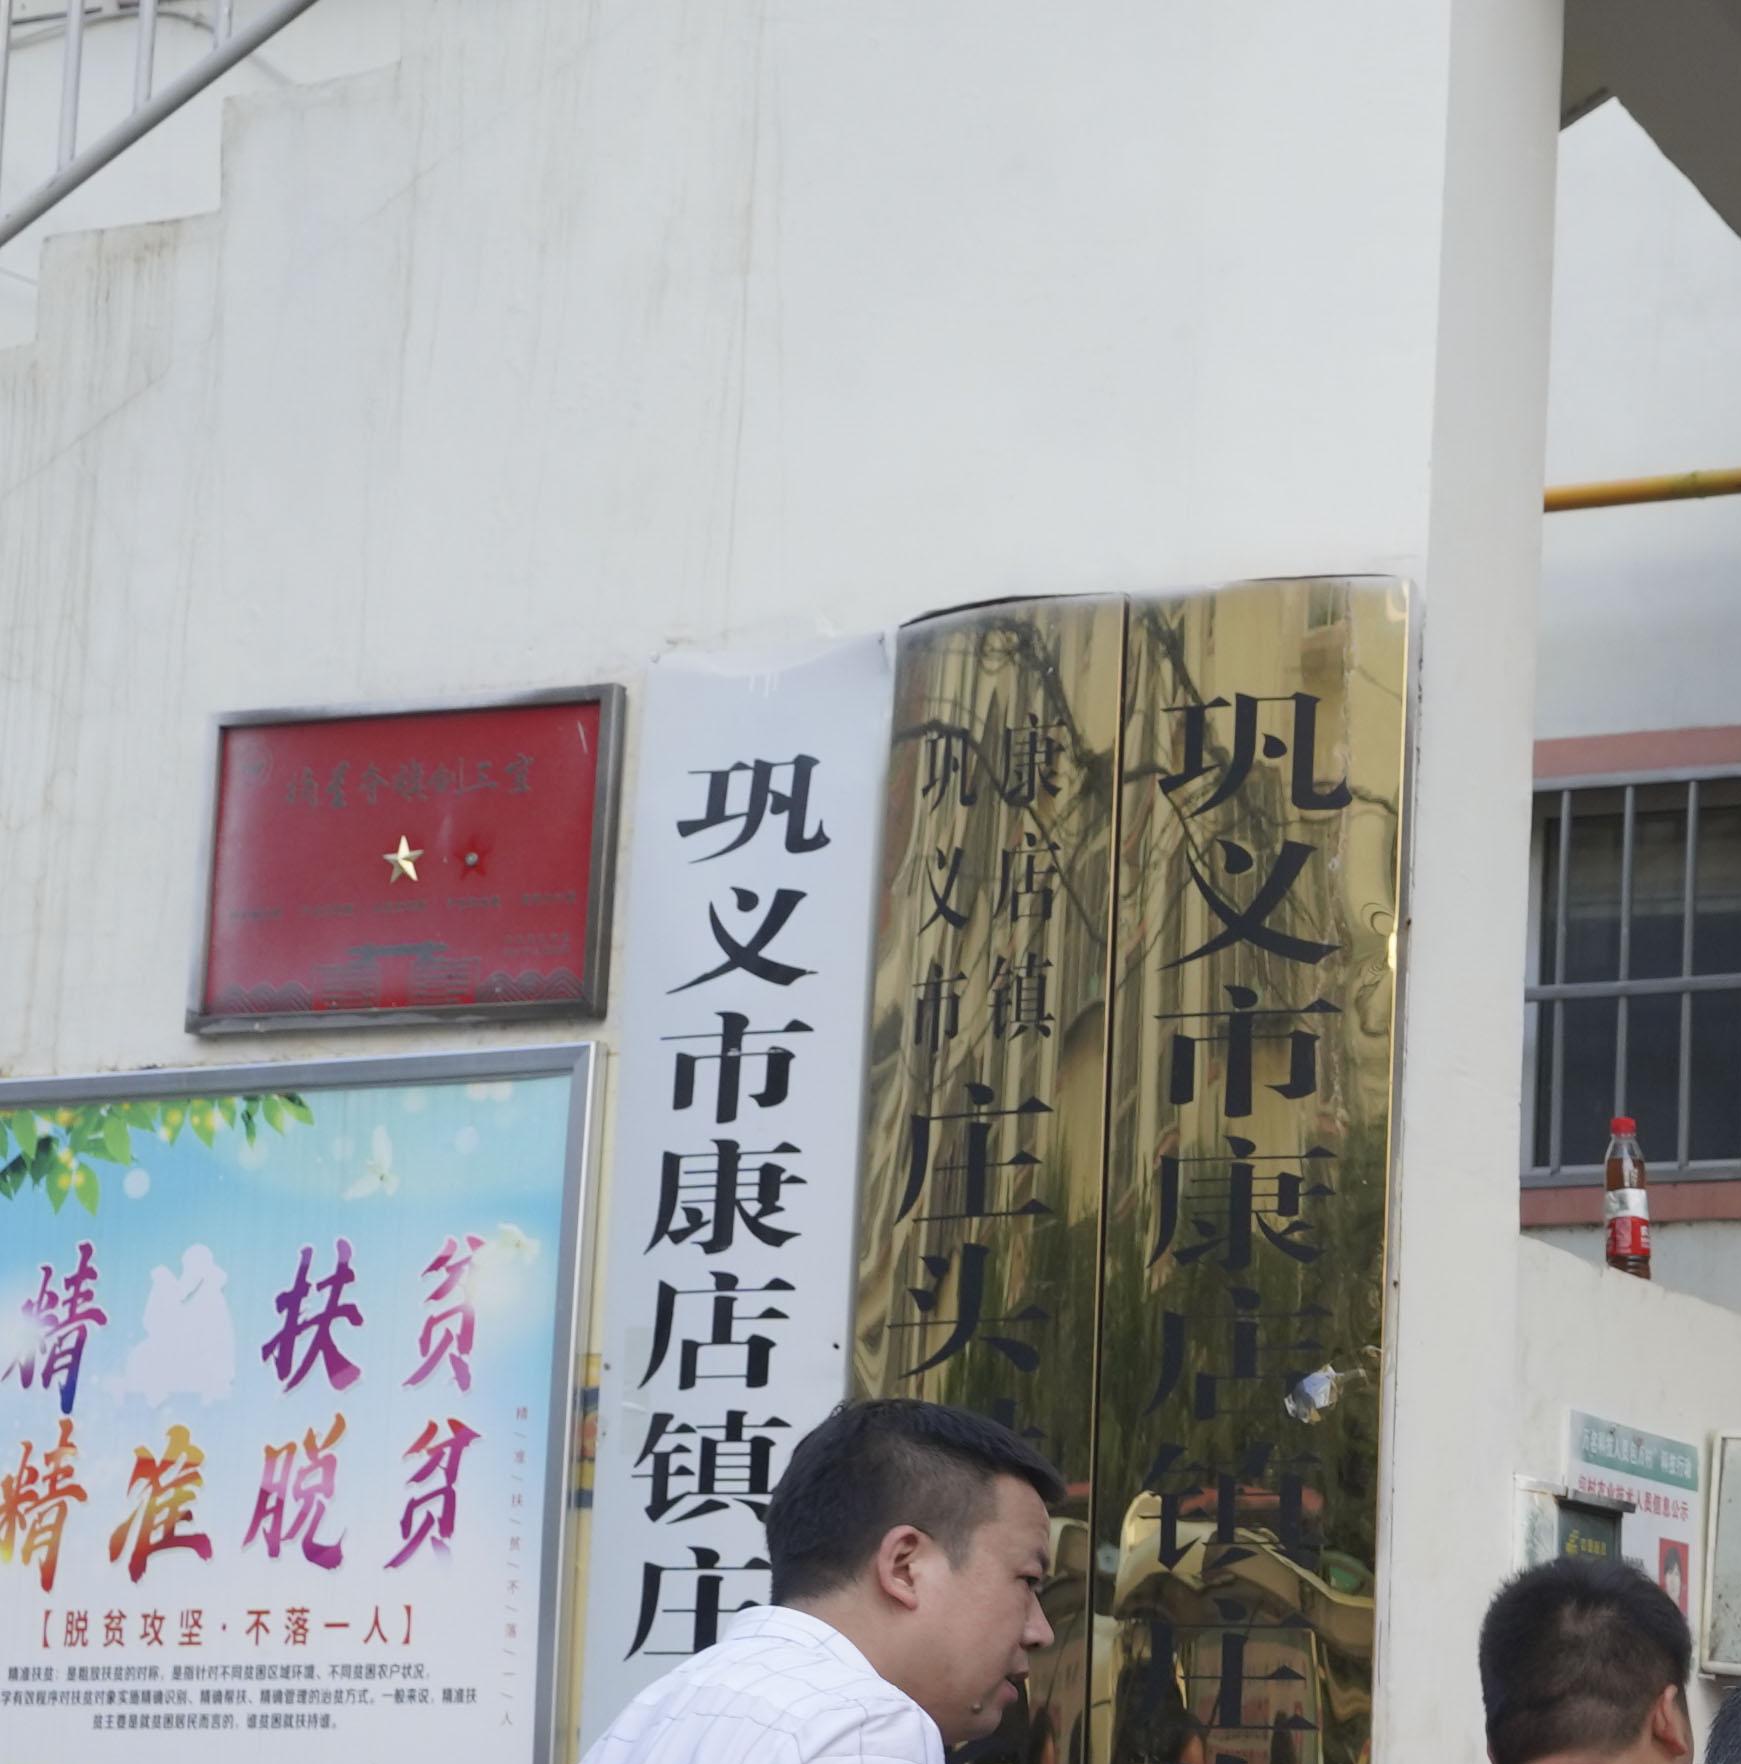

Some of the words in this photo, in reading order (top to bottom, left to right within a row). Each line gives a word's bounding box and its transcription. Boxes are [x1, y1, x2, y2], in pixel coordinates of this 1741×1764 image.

[912, 728, 977, 1046] 巩义市
[991, 712, 1067, 1042] 康店镇
[622, 752, 832, 1662] 巩义市康店镇庄
[0, 1412, 483, 1593] 精准脱贫
